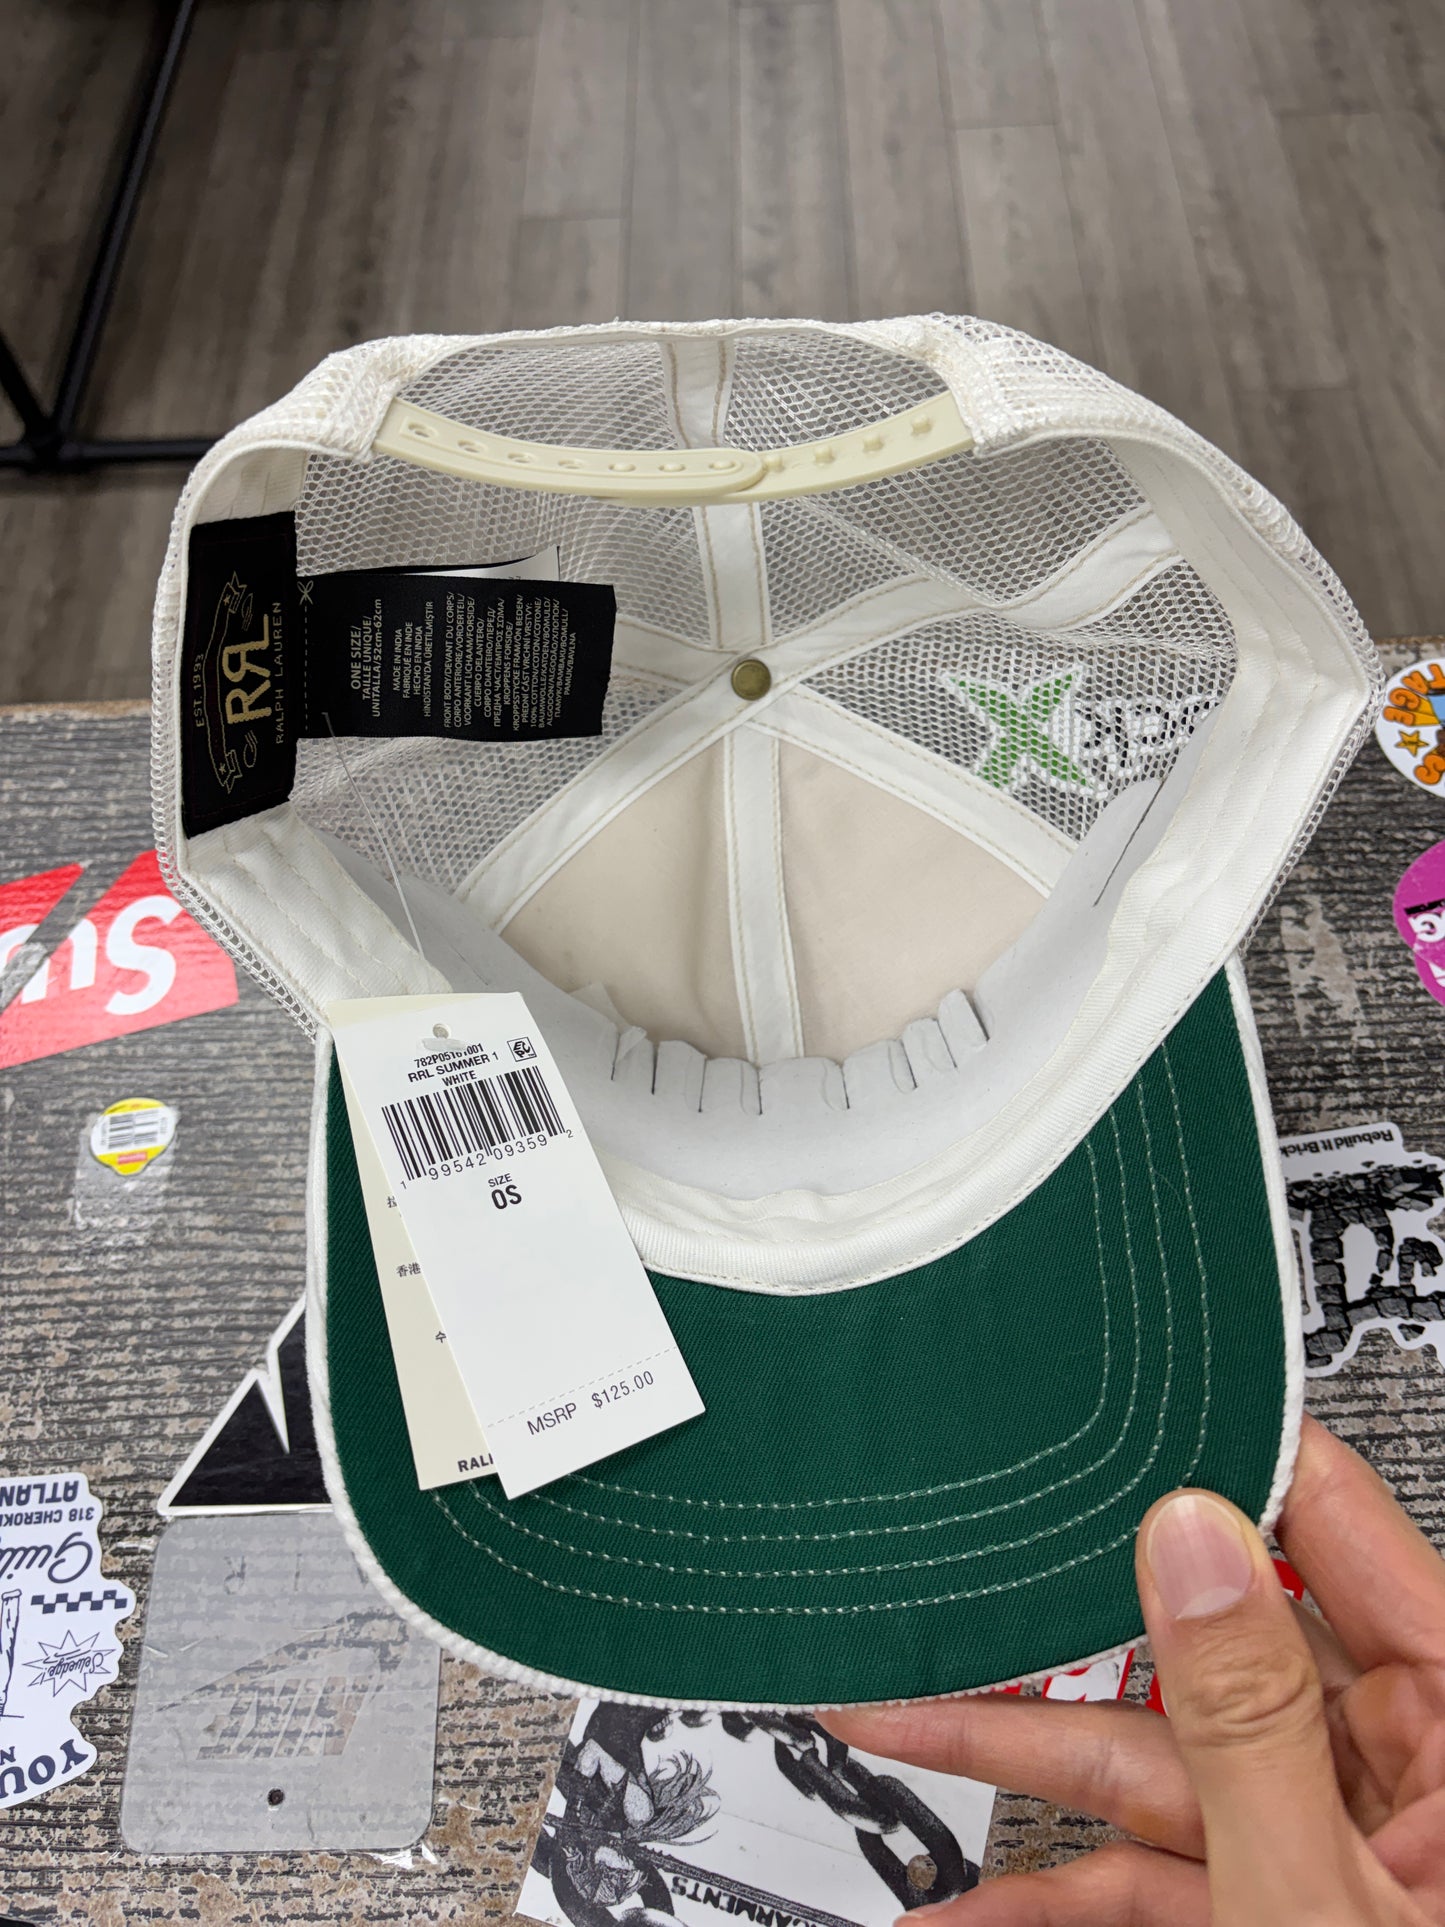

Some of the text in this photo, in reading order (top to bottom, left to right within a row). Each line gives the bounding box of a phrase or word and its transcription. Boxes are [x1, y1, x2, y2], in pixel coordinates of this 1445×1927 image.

[446, 626, 454, 638] DU
[351, 626, 361, 690] ONE SIZE/
[362, 616, 372, 700] TAILLE UNIQUE/
[394, 655, 401, 664] IN
[404, 644, 412, 655] EN
[413, 626, 423, 695] HECHO EN INDIA
[272, 602, 284, 744] RALPH LAUREN
[444, 641, 453, 700] BODY/DEVANT
[503, 662, 512, 705] KROPPENS
[464, 680, 472, 726] VOORKANT
[474, 674, 482, 707] CUERPO
[484, 689, 492, 718] CORPO
[193, 695, 205, 727] EST.
[444, 702, 452, 728] FRONT
[454, 699, 462, 728] CORPO
[408, 1052, 499, 1082] RRL SUMMER 1
[442, 1070, 477, 1087] WHITE
[428, 1153, 486, 1180] 99542
[493, 1134, 548, 1160] 09359
[565, 1129, 574, 1138] 2
[1322, 1138, 1333, 1151] It
[1336, 1129, 1394, 1149] Rebuild
[487, 1173, 512, 1187] SIZE
[527, 1370, 654, 1435] MSRP $125.00
[0, 1507, 95, 1527] 318 CHEROK
[41, 1652, 104, 1685] Selvedge!
